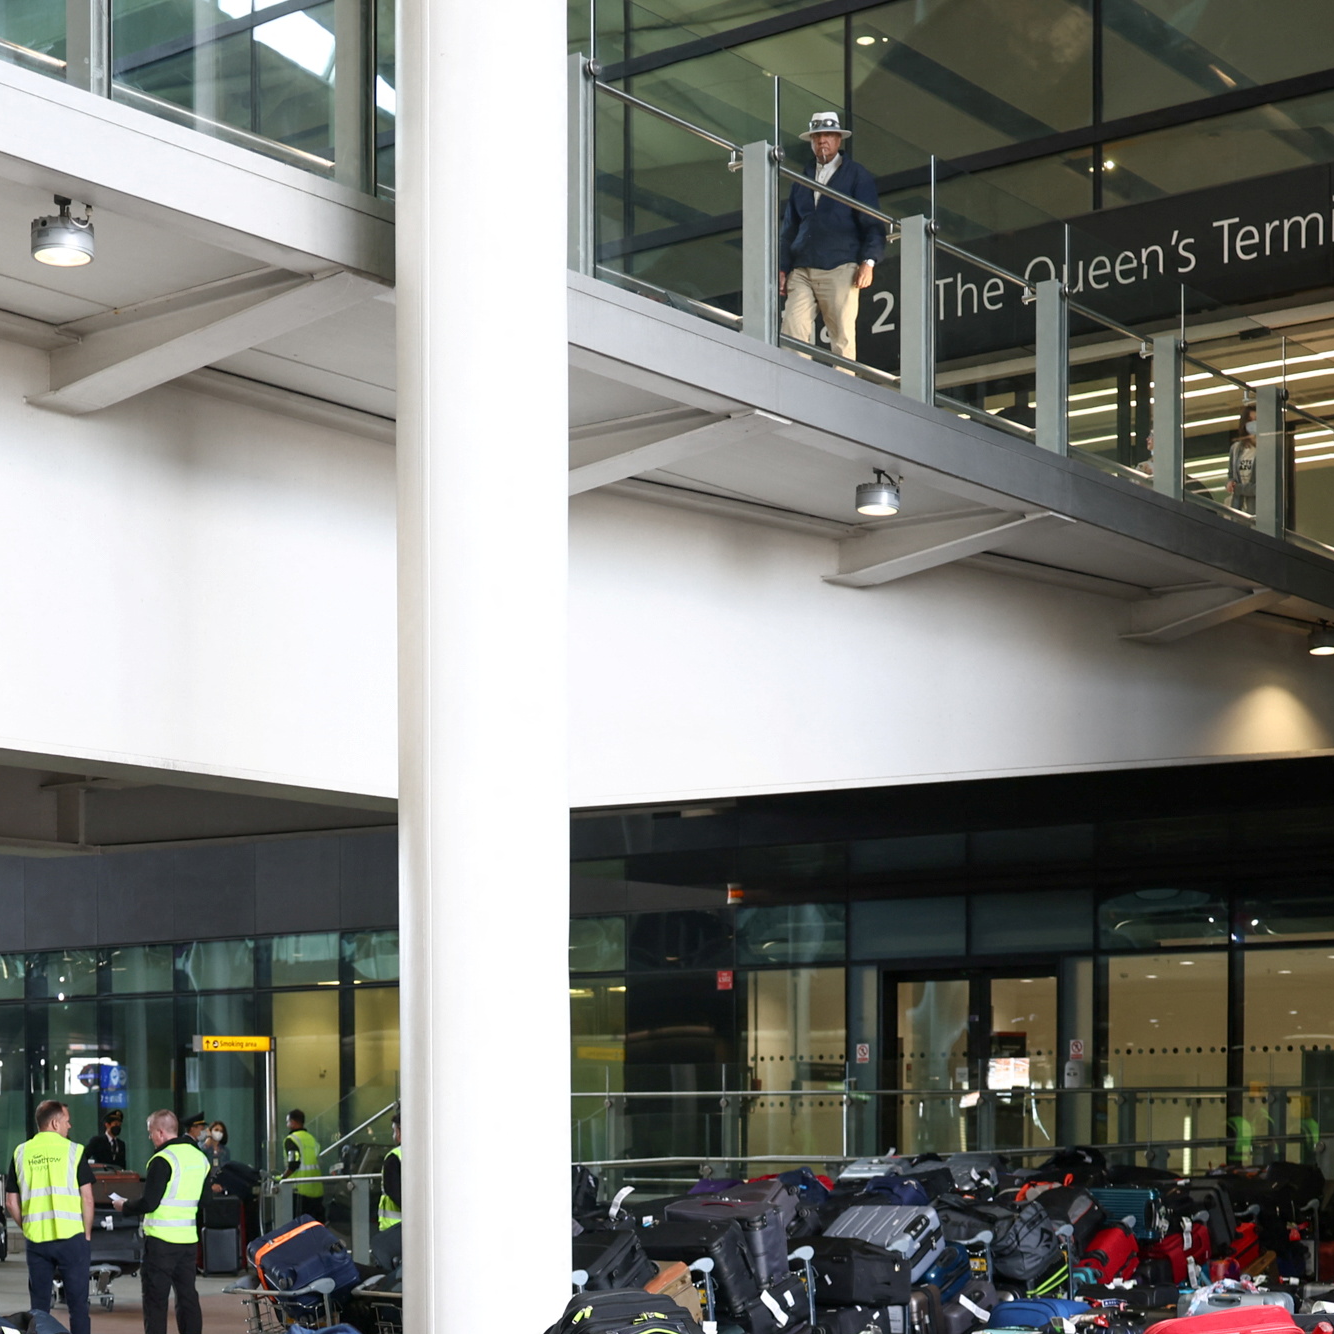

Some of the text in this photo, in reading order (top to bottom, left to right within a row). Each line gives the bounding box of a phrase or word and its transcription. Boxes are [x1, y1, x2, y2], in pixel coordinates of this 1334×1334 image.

[871, 291, 896, 335] 2
[934, 273, 1004, 321] The
[220, 1040, 244, 1048] Smoking
[28, 1157, 61, 1166] Heathrow
